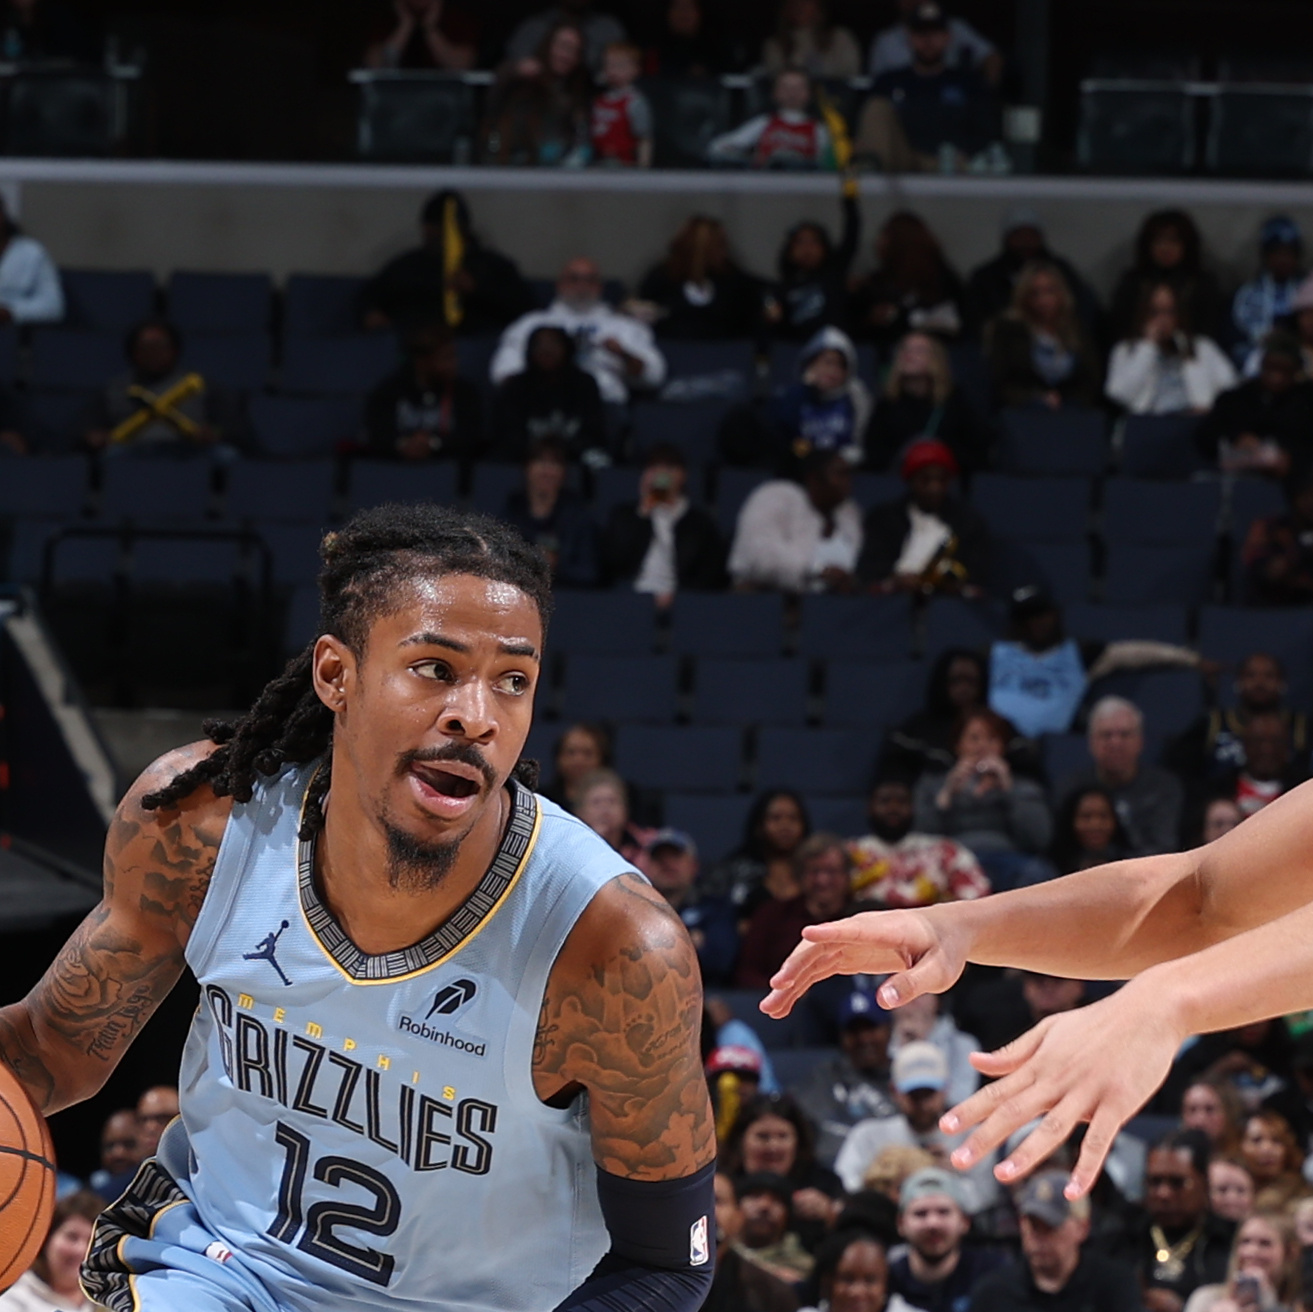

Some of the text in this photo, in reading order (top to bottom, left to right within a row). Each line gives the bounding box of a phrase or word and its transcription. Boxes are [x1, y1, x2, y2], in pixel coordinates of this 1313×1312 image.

[205, 983, 498, 1176] GRIZZLIES
[237, 992, 458, 1100] MEMPHIS
[399, 1016, 486, 1057] Robinhood
[266, 1120, 402, 1287] 12
